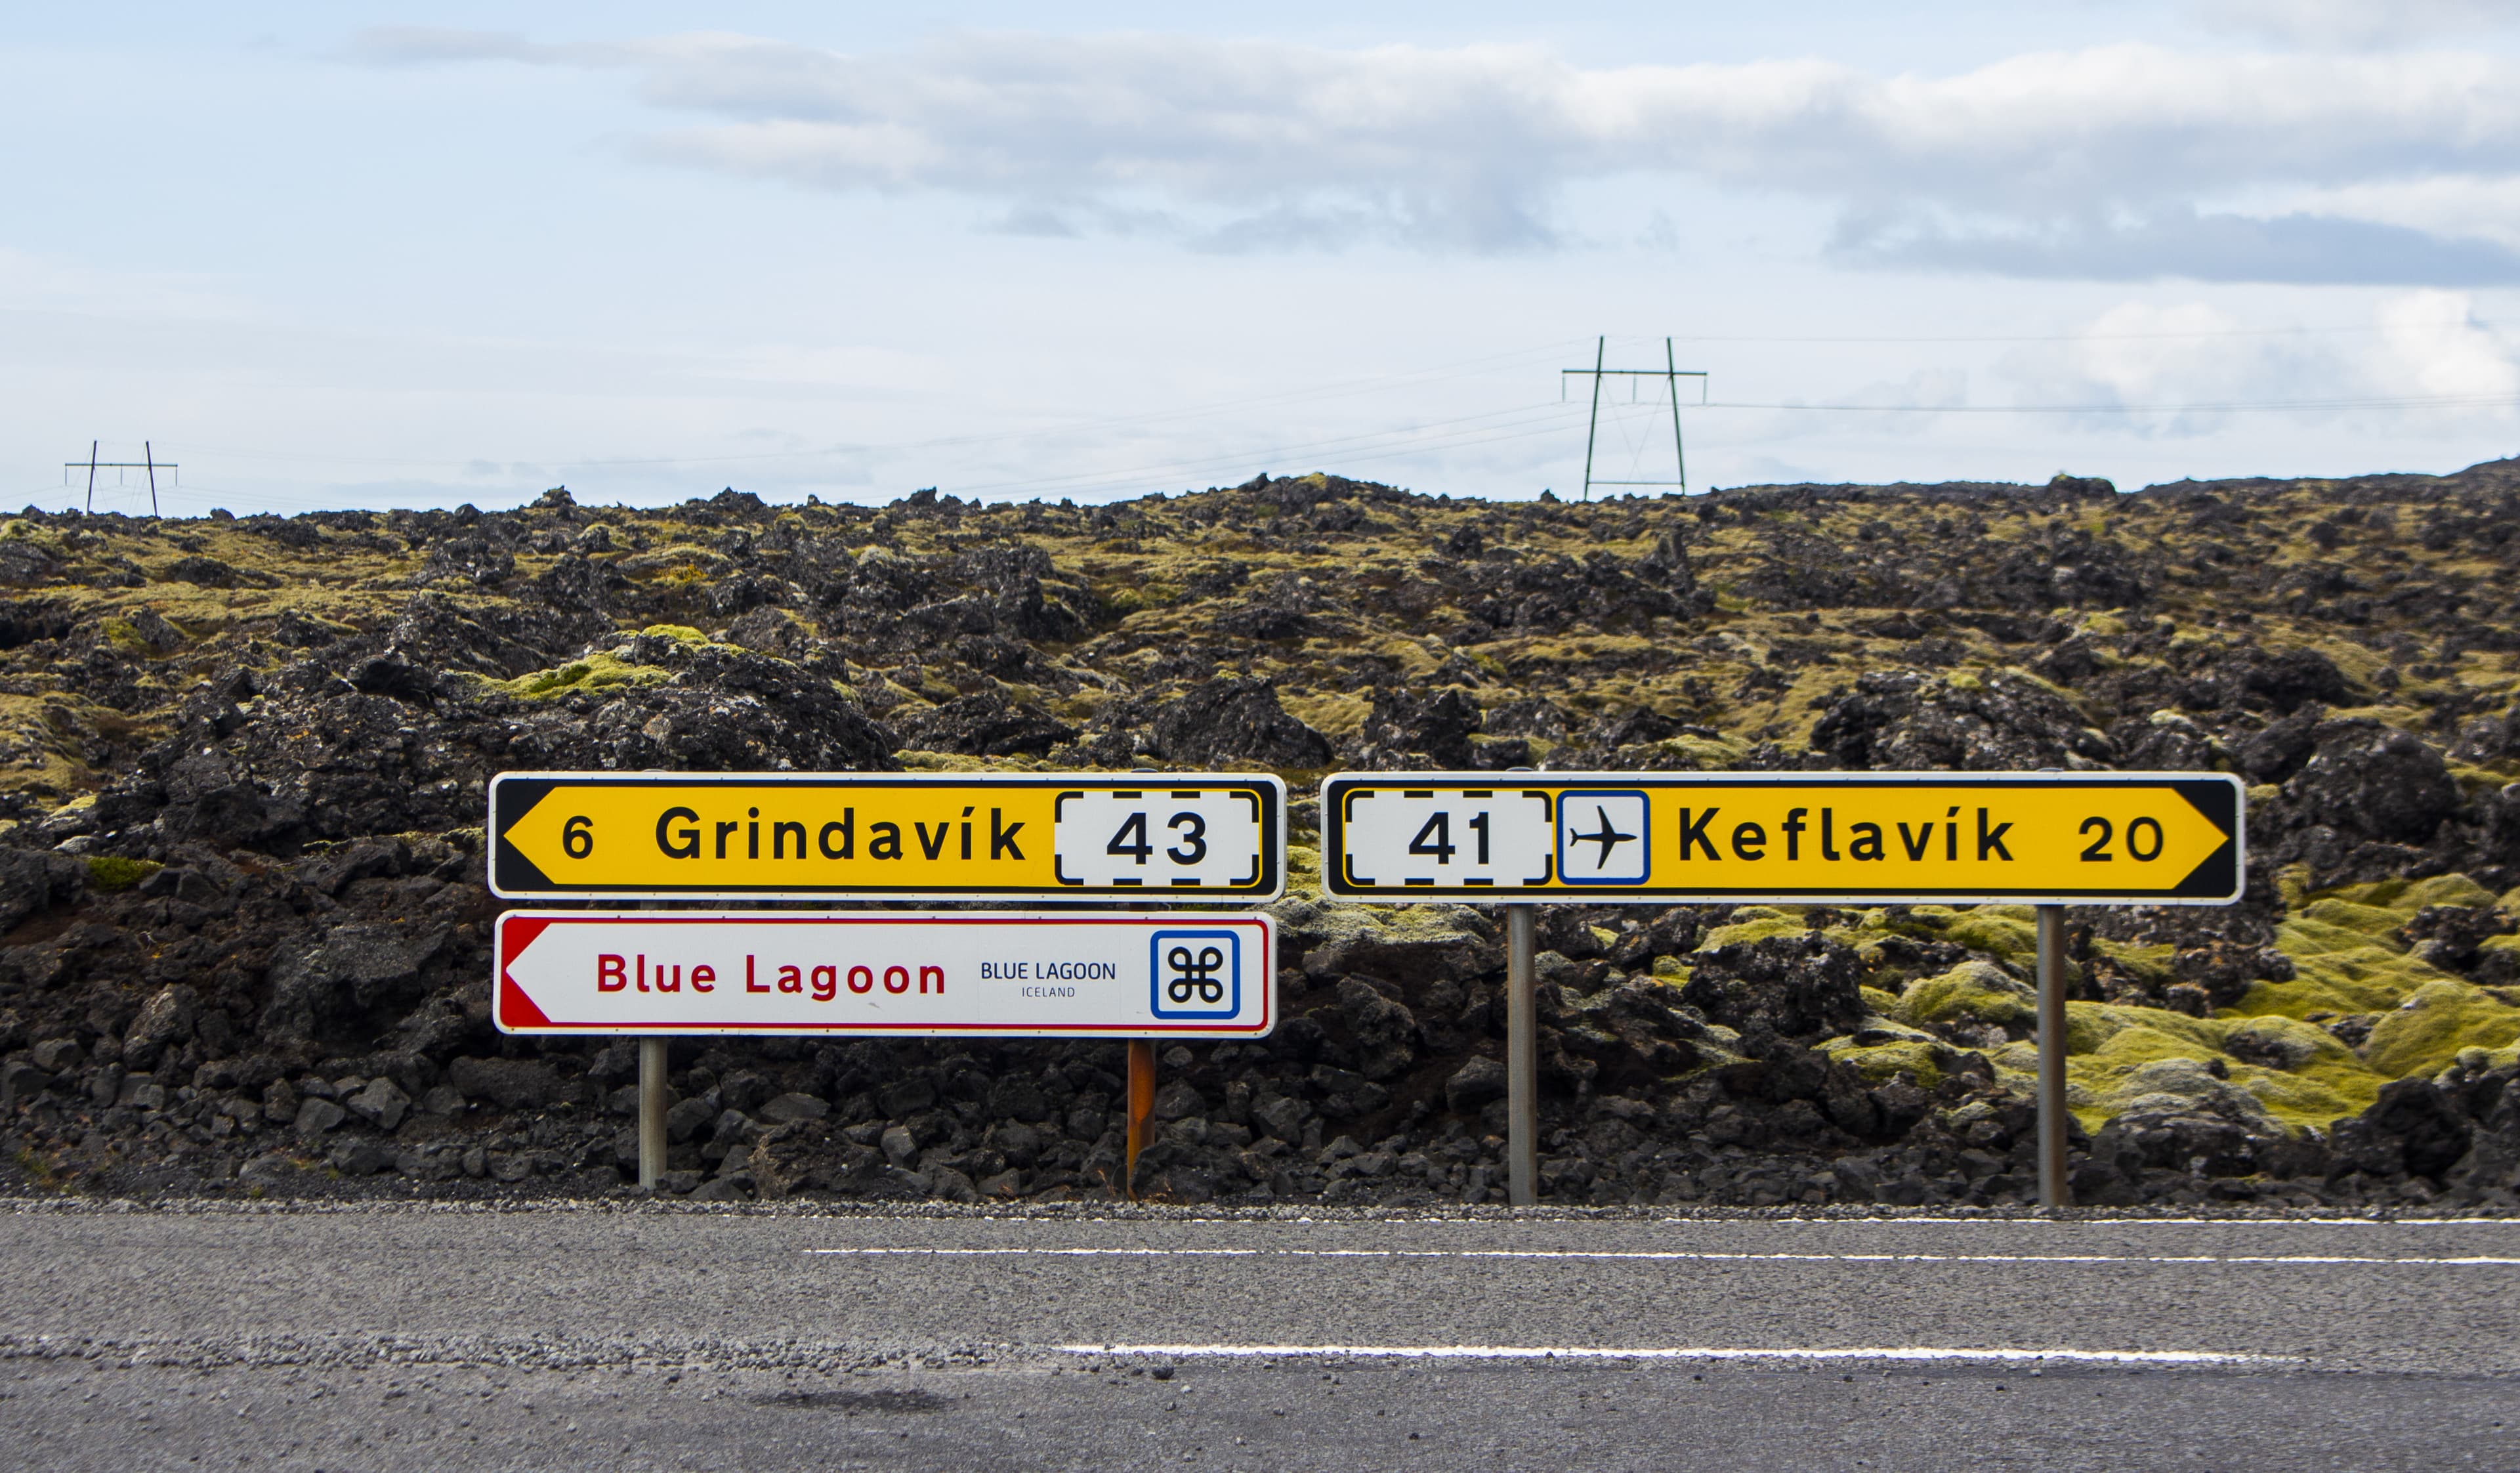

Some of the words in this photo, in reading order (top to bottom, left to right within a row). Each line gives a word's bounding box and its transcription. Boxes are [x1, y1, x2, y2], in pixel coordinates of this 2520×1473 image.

[562, 815, 594, 860] 6
[656, 806, 1026, 861] Grindavík
[1106, 811, 1207, 865] 43
[1408, 811, 1489, 865] 41
[1679, 806, 2014, 862] Keflavík
[2078, 816, 2164, 863] 20
[598, 954, 716, 993] Blue
[746, 954, 944, 1002] Lagoon
[981, 962, 1028, 979] BLUE
[1036, 962, 1116, 980] LAGOON
[1022, 987, 1076, 998] ICELAND
